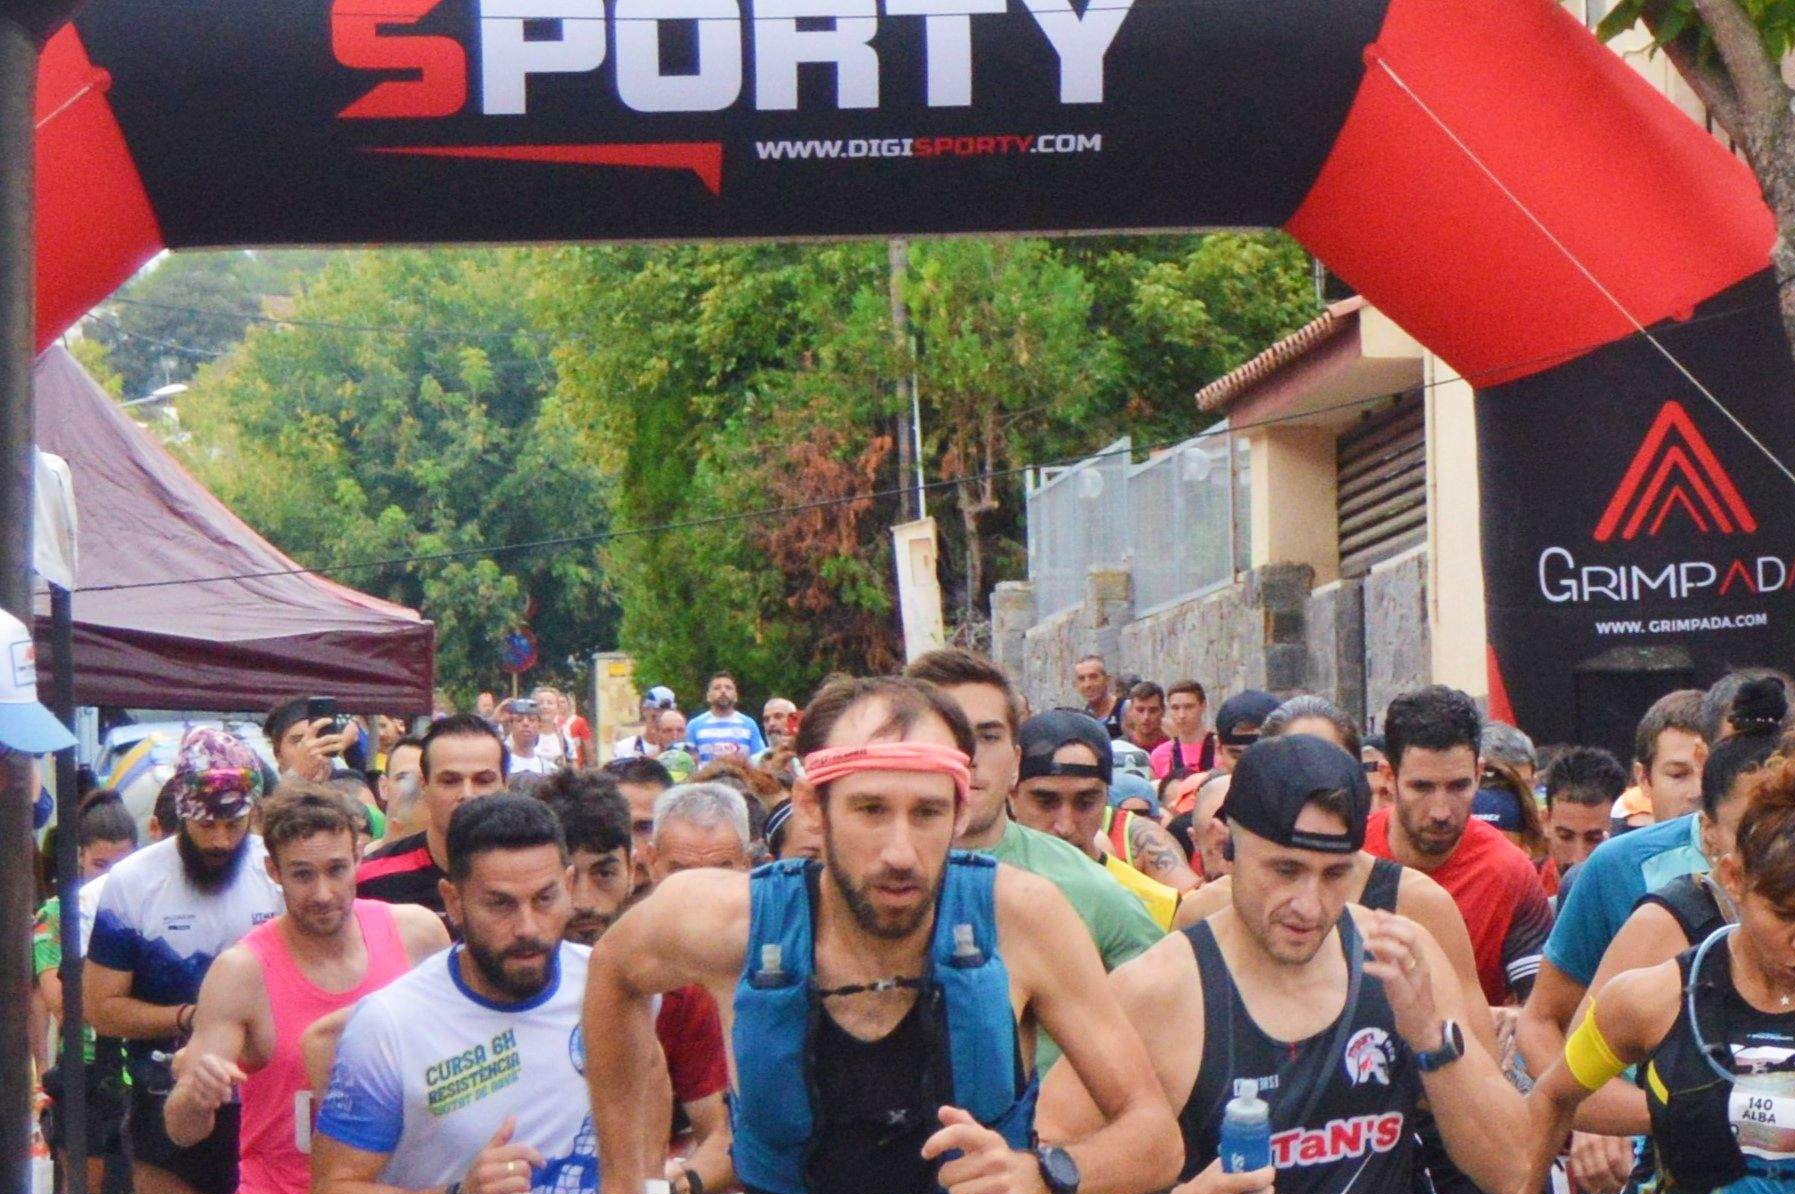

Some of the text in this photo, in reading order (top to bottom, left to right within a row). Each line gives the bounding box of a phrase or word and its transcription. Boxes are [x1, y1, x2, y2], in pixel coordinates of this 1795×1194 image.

[330, 0, 1138, 119] SPORTY
[754, 133, 1102, 160] WWW.DIGISPORTY.COM
[1648, 612, 1768, 633] GRIMPADA.COM
[426, 1027, 517, 1086] CURSA 6H
[1748, 1096, 1773, 1111] 140
[1742, 1109, 1776, 1125] ALBA
